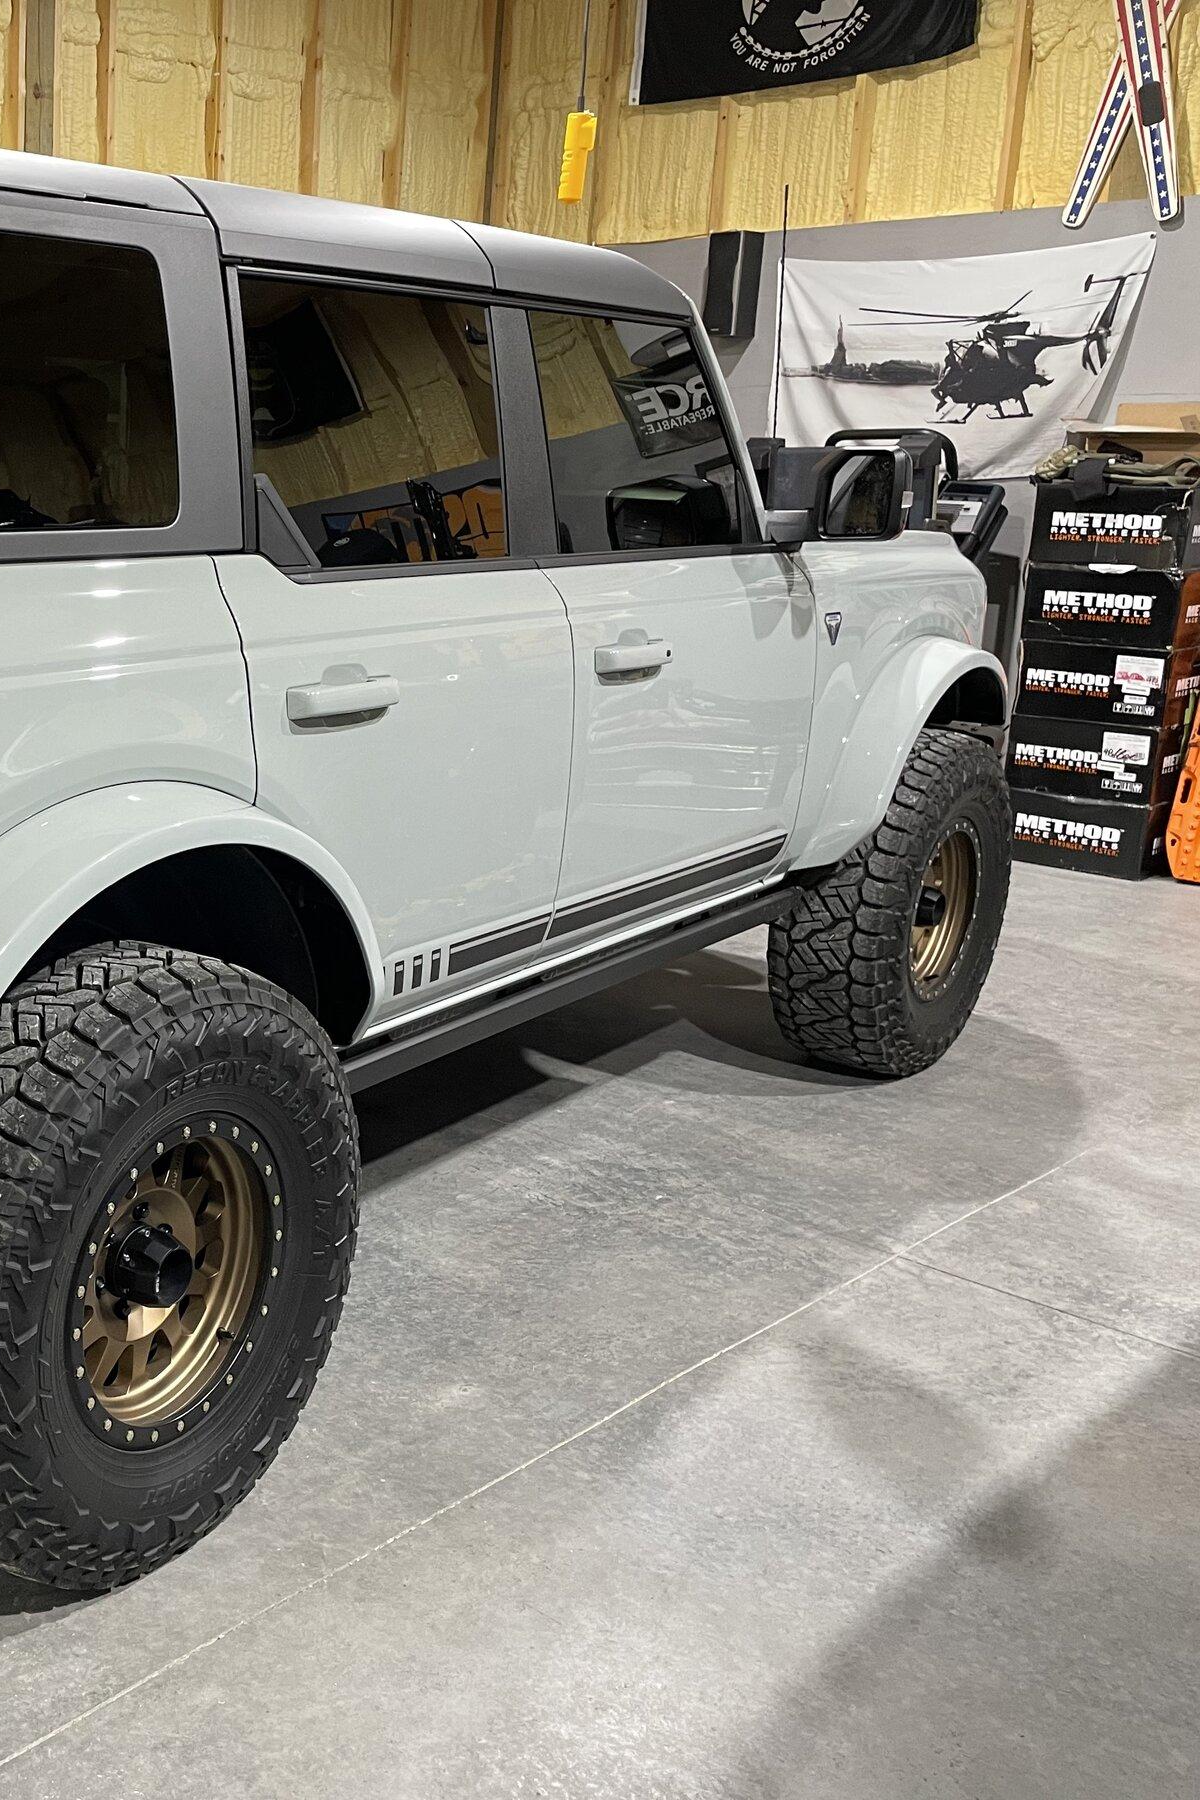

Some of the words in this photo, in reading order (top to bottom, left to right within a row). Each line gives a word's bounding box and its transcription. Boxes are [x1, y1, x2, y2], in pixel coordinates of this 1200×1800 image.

[730, 33, 747, 56] YOU
[745, 54, 769, 71] ARE
[773, 62, 796, 74] NOT
[803, 12, 871, 69] FORGOTTEN
[1051, 511, 1163, 530] METHOD
[1050, 526, 1087, 535] RACE
[1096, 528, 1160, 537] WHEELS
[1043, 589, 1152, 610] METHOD
[1042, 605, 1079, 614] RACE
[1087, 607, 1150, 618] WHEELS
[1025, 679, 1054, 687] RACE
[1060, 682, 1109, 692] WHEELS
[1026, 667, 1110, 687] METHOD
[1015, 754, 1044, 763] RACE
[1049, 757, 1097, 769] WHEELS
[1016, 742, 1098, 763] METHOD
[1016, 812, 1121, 842] METHOD
[1014, 826, 1049, 839] RACE
[1057, 833, 1118, 849] WHEELS
